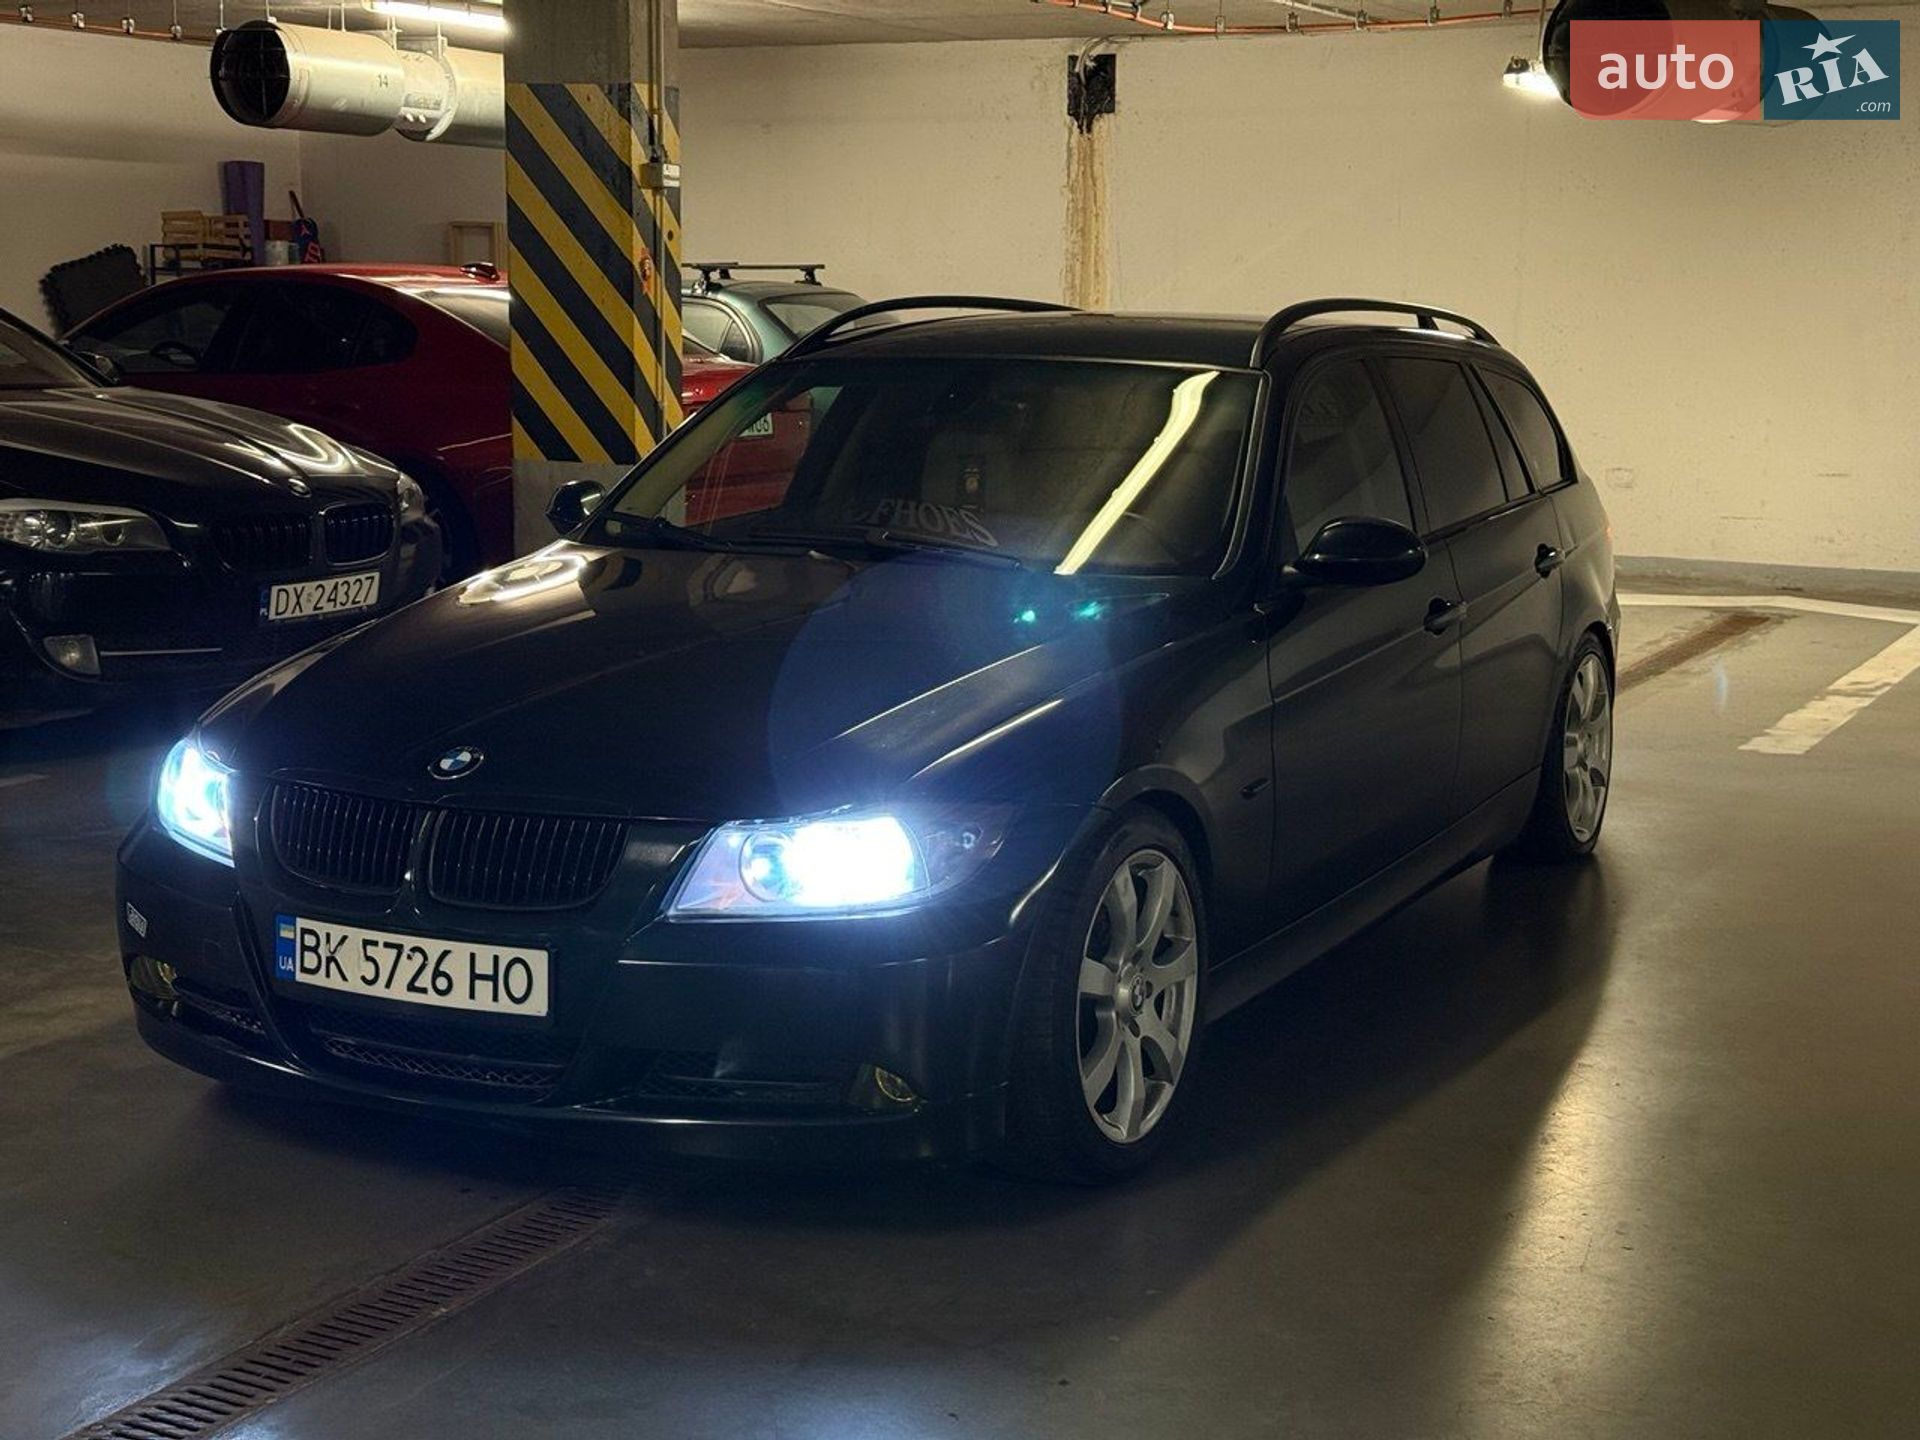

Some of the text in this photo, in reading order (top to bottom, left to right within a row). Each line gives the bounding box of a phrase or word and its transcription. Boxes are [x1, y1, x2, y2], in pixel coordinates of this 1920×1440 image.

[275, 576, 375, 616] DX 24327
[279, 955, 294, 972] UA
[300, 927, 533, 1005] BK 5726 HO
